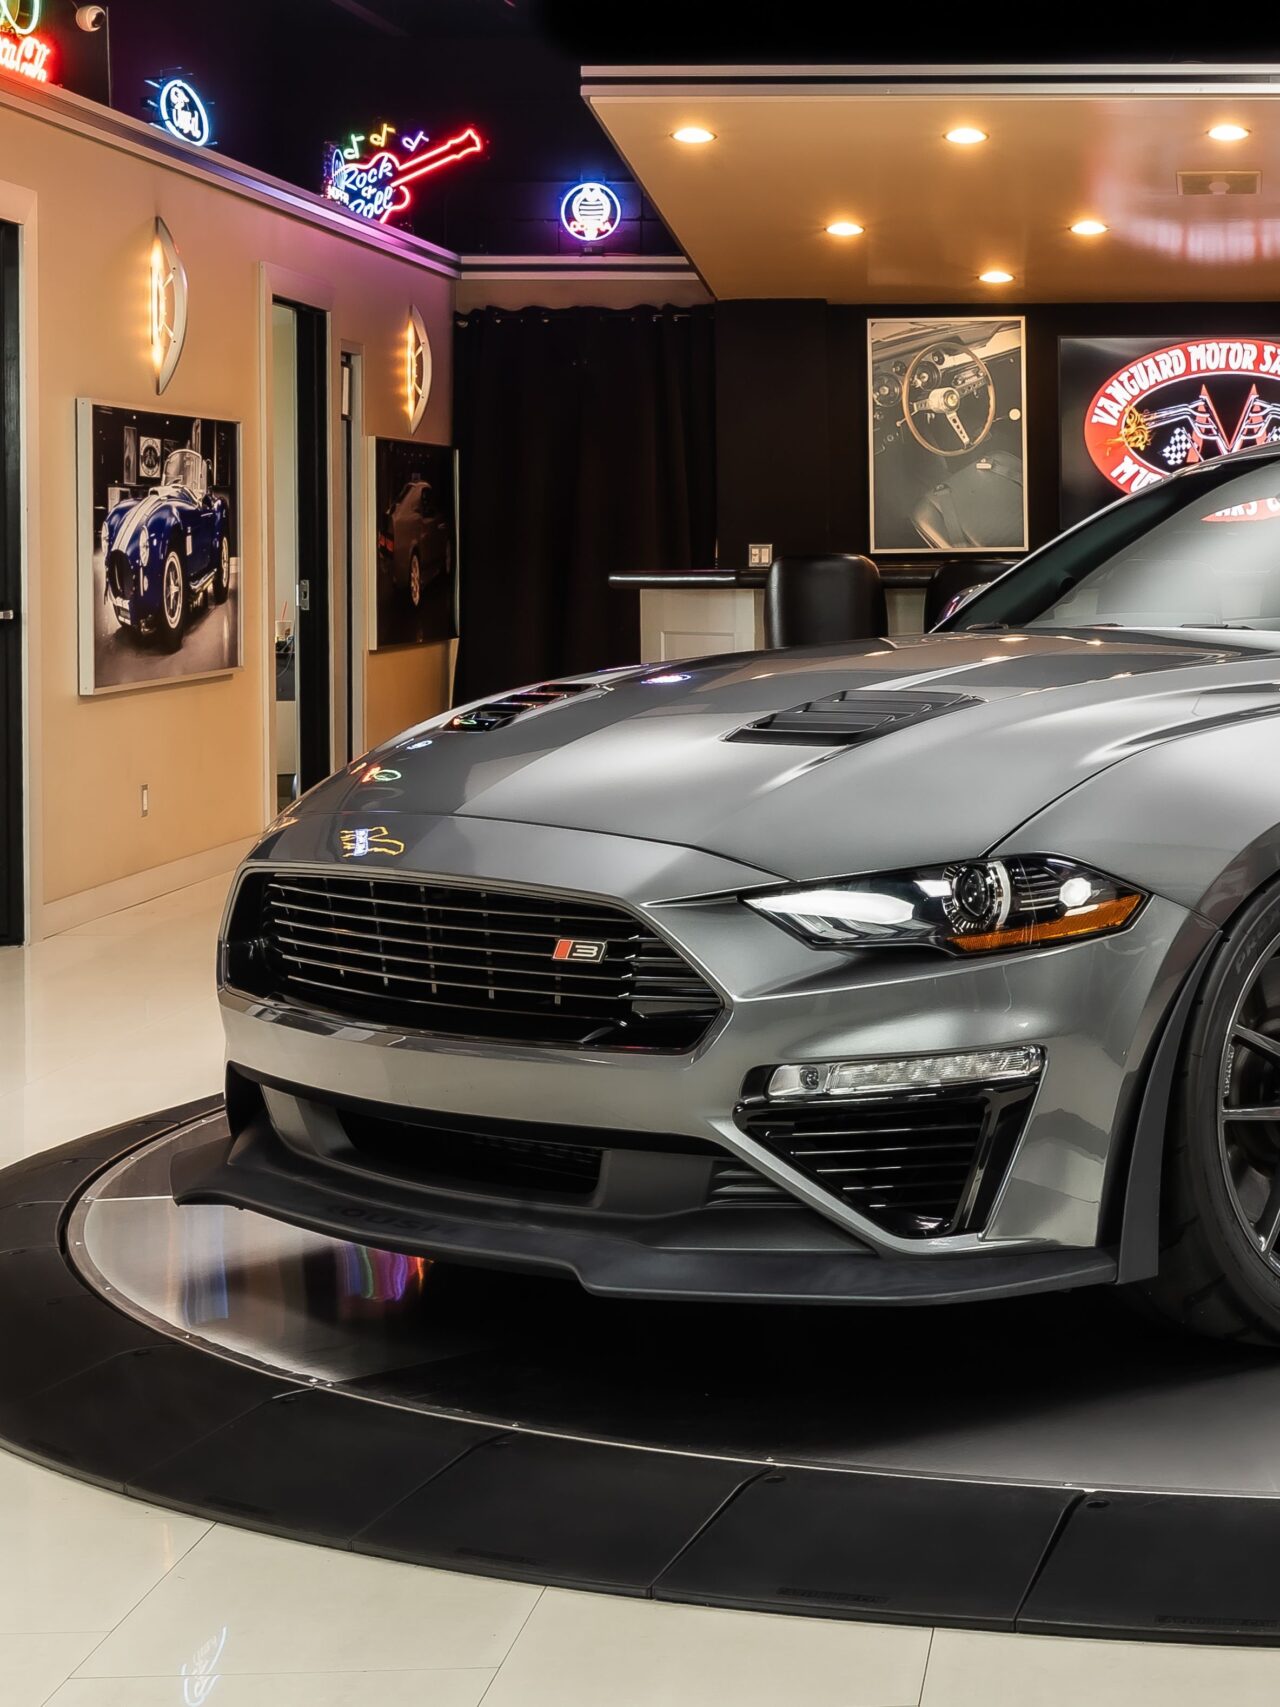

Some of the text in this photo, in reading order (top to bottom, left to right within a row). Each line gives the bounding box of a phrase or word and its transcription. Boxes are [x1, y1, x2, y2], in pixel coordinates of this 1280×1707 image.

[344, 156, 393, 191] Rock
[1091, 350, 1187, 426] VANGUARD
[1187, 342, 1258, 372] MOTOR
